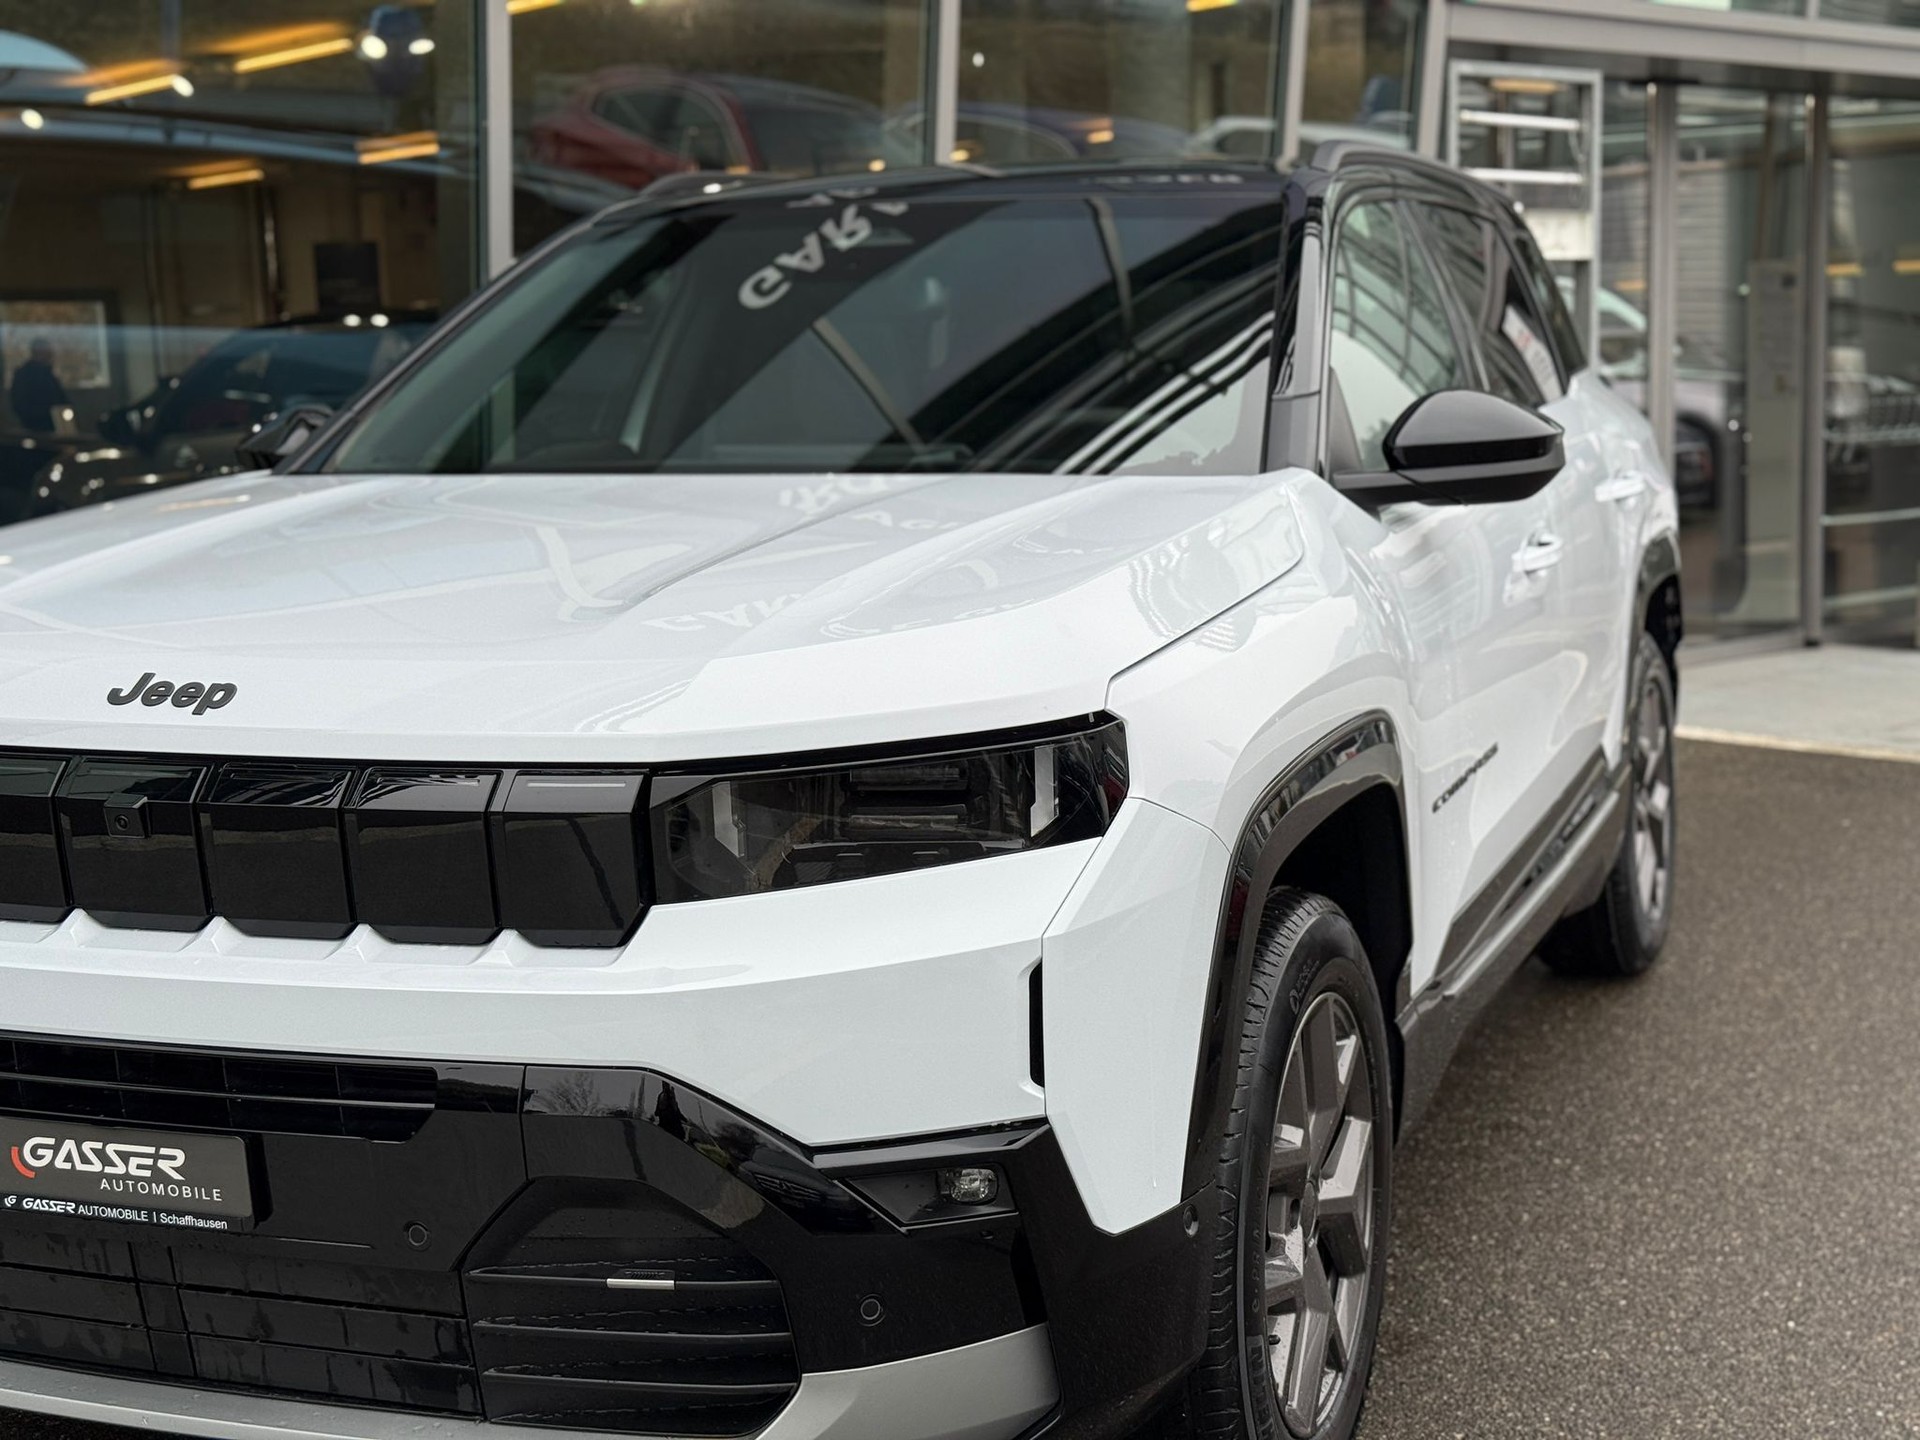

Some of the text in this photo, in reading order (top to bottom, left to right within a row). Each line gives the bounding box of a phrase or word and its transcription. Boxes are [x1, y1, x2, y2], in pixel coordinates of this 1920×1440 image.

[107, 672, 237, 715] Jeep
[23, 1136, 187, 1180] GASSER
[100, 1178, 223, 1202] AUTOMOBILE
[22, 1197, 76, 1214] GASSER
[77, 1204, 149, 1222] AUTOMOBILE
[160, 1212, 228, 1230] Schaffhausen
